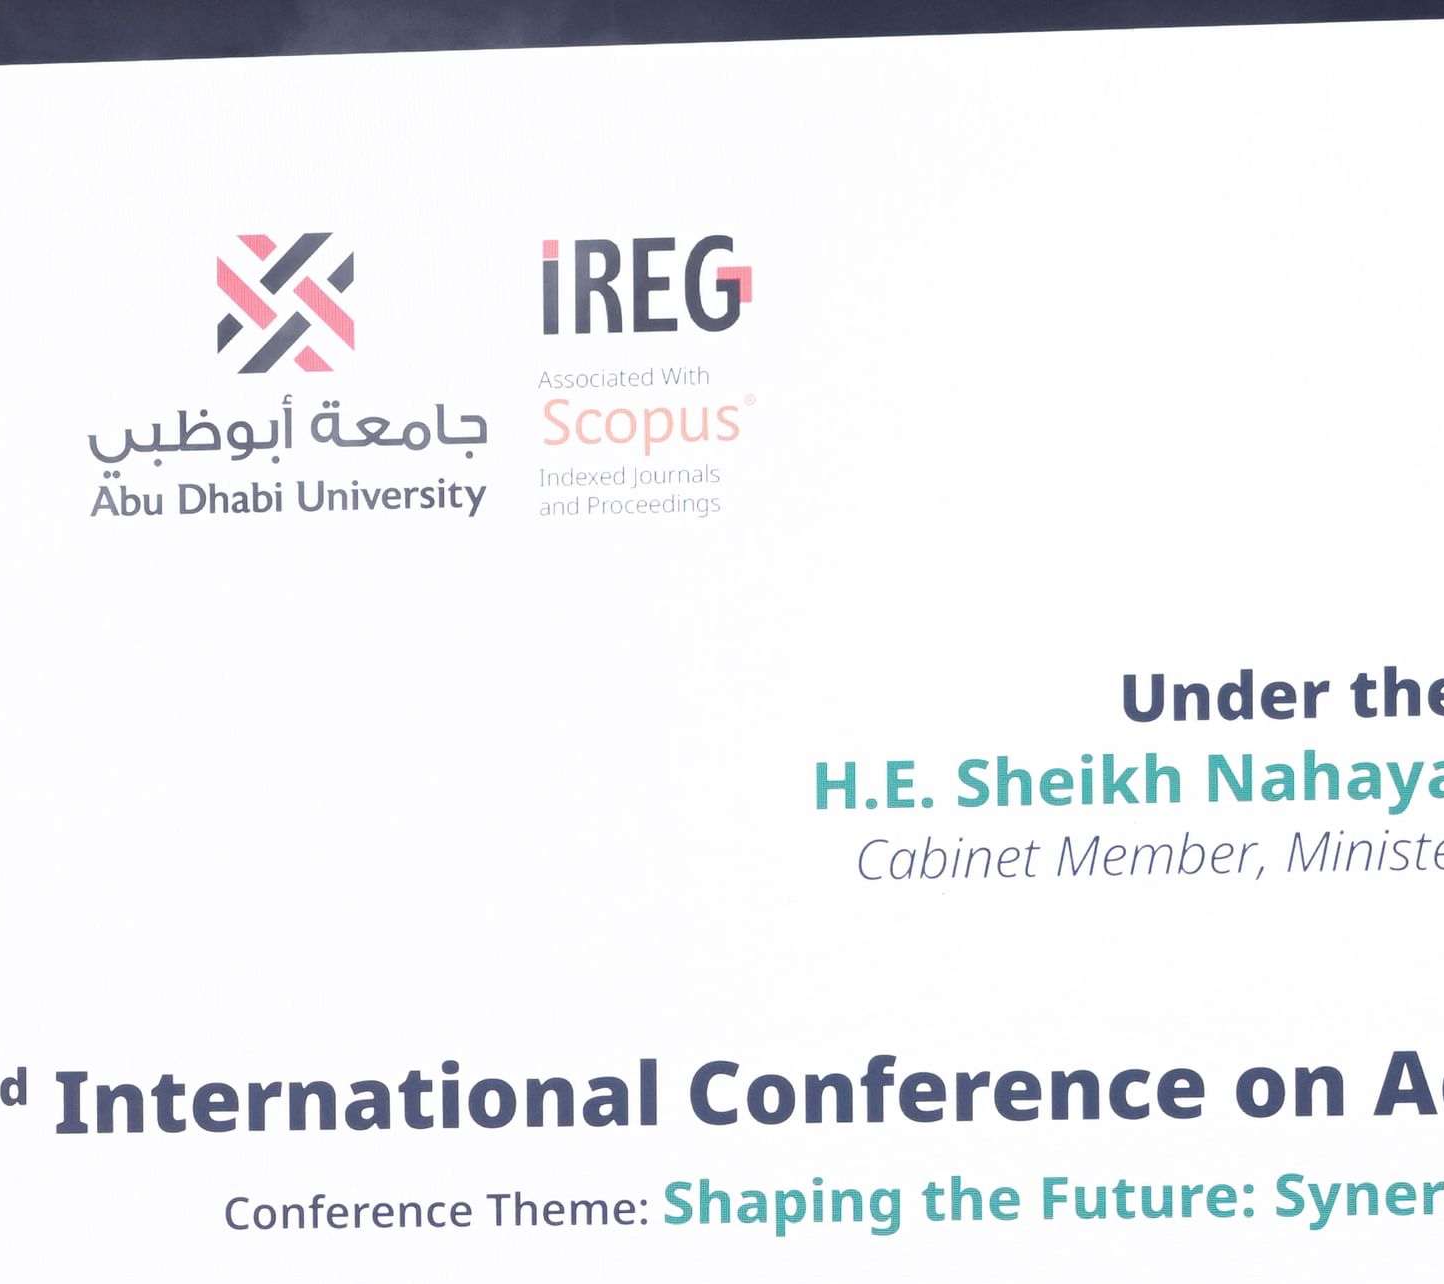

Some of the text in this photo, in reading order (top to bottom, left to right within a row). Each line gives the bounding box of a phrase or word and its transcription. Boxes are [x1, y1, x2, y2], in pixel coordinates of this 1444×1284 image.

[537, 365, 710, 390] Associated With
[87, 393, 488, 480] جامعة أبوظبي
[89, 479, 487, 518] Abu Dhabi University
[539, 463, 721, 489] Indexed Journals
[539, 493, 721, 519] and Proceedings
[1122, 668, 1331, 724] Under
[815, 759, 935, 811] H.E.
[957, 751, 1182, 809] Sheikh
[857, 835, 1042, 881] Cabinet
[1056, 831, 1265, 881] Member,
[55, 1057, 658, 1135] International
[689, 1053, 1206, 1127] Conference
[1235, 1065, 1345, 1119] on
[224, 1193, 473, 1231] Conference
[485, 1190, 648, 1227] Theme:
[663, 1177, 901, 1238] Shaping
[921, 1174, 1021, 1222] the
[1042, 1176, 1255, 1221] Future:
